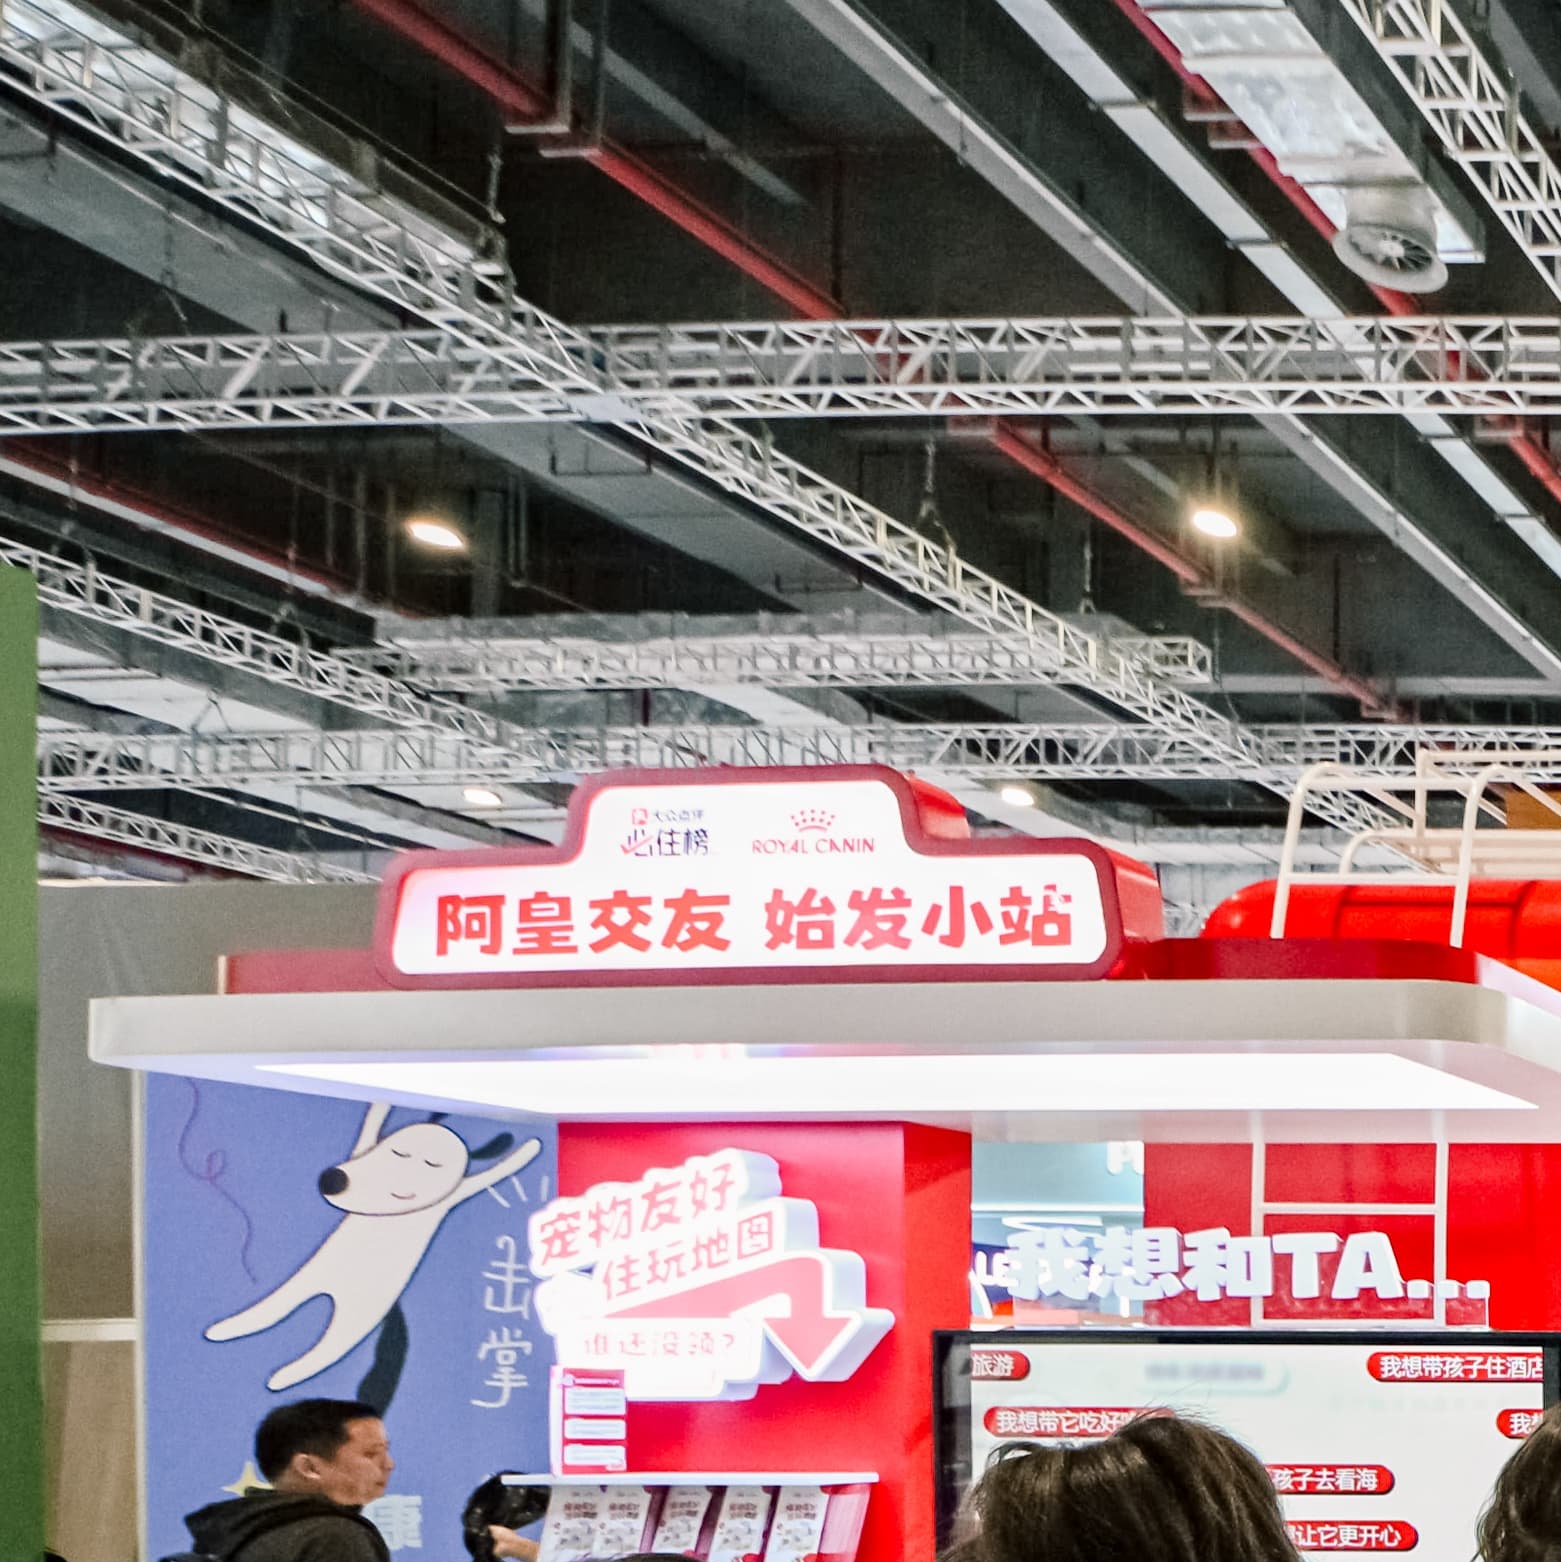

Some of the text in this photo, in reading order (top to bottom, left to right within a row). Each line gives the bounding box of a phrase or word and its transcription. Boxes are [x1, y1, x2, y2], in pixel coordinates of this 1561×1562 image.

[621, 829, 709, 857] 必住榜
[752, 837, 876, 855] ROYAL CANIN
[436, 884, 1072, 956] 阿皇交友 始发小站
[539, 1163, 735, 1266] 宠物友好
[603, 1211, 774, 1301] 住玩地图
[470, 1235, 532, 1409] 击掌
[1379, 1355, 1543, 1379] 我想带孩子住酒店
[1269, 1468, 1378, 1491] 孩子去看海
